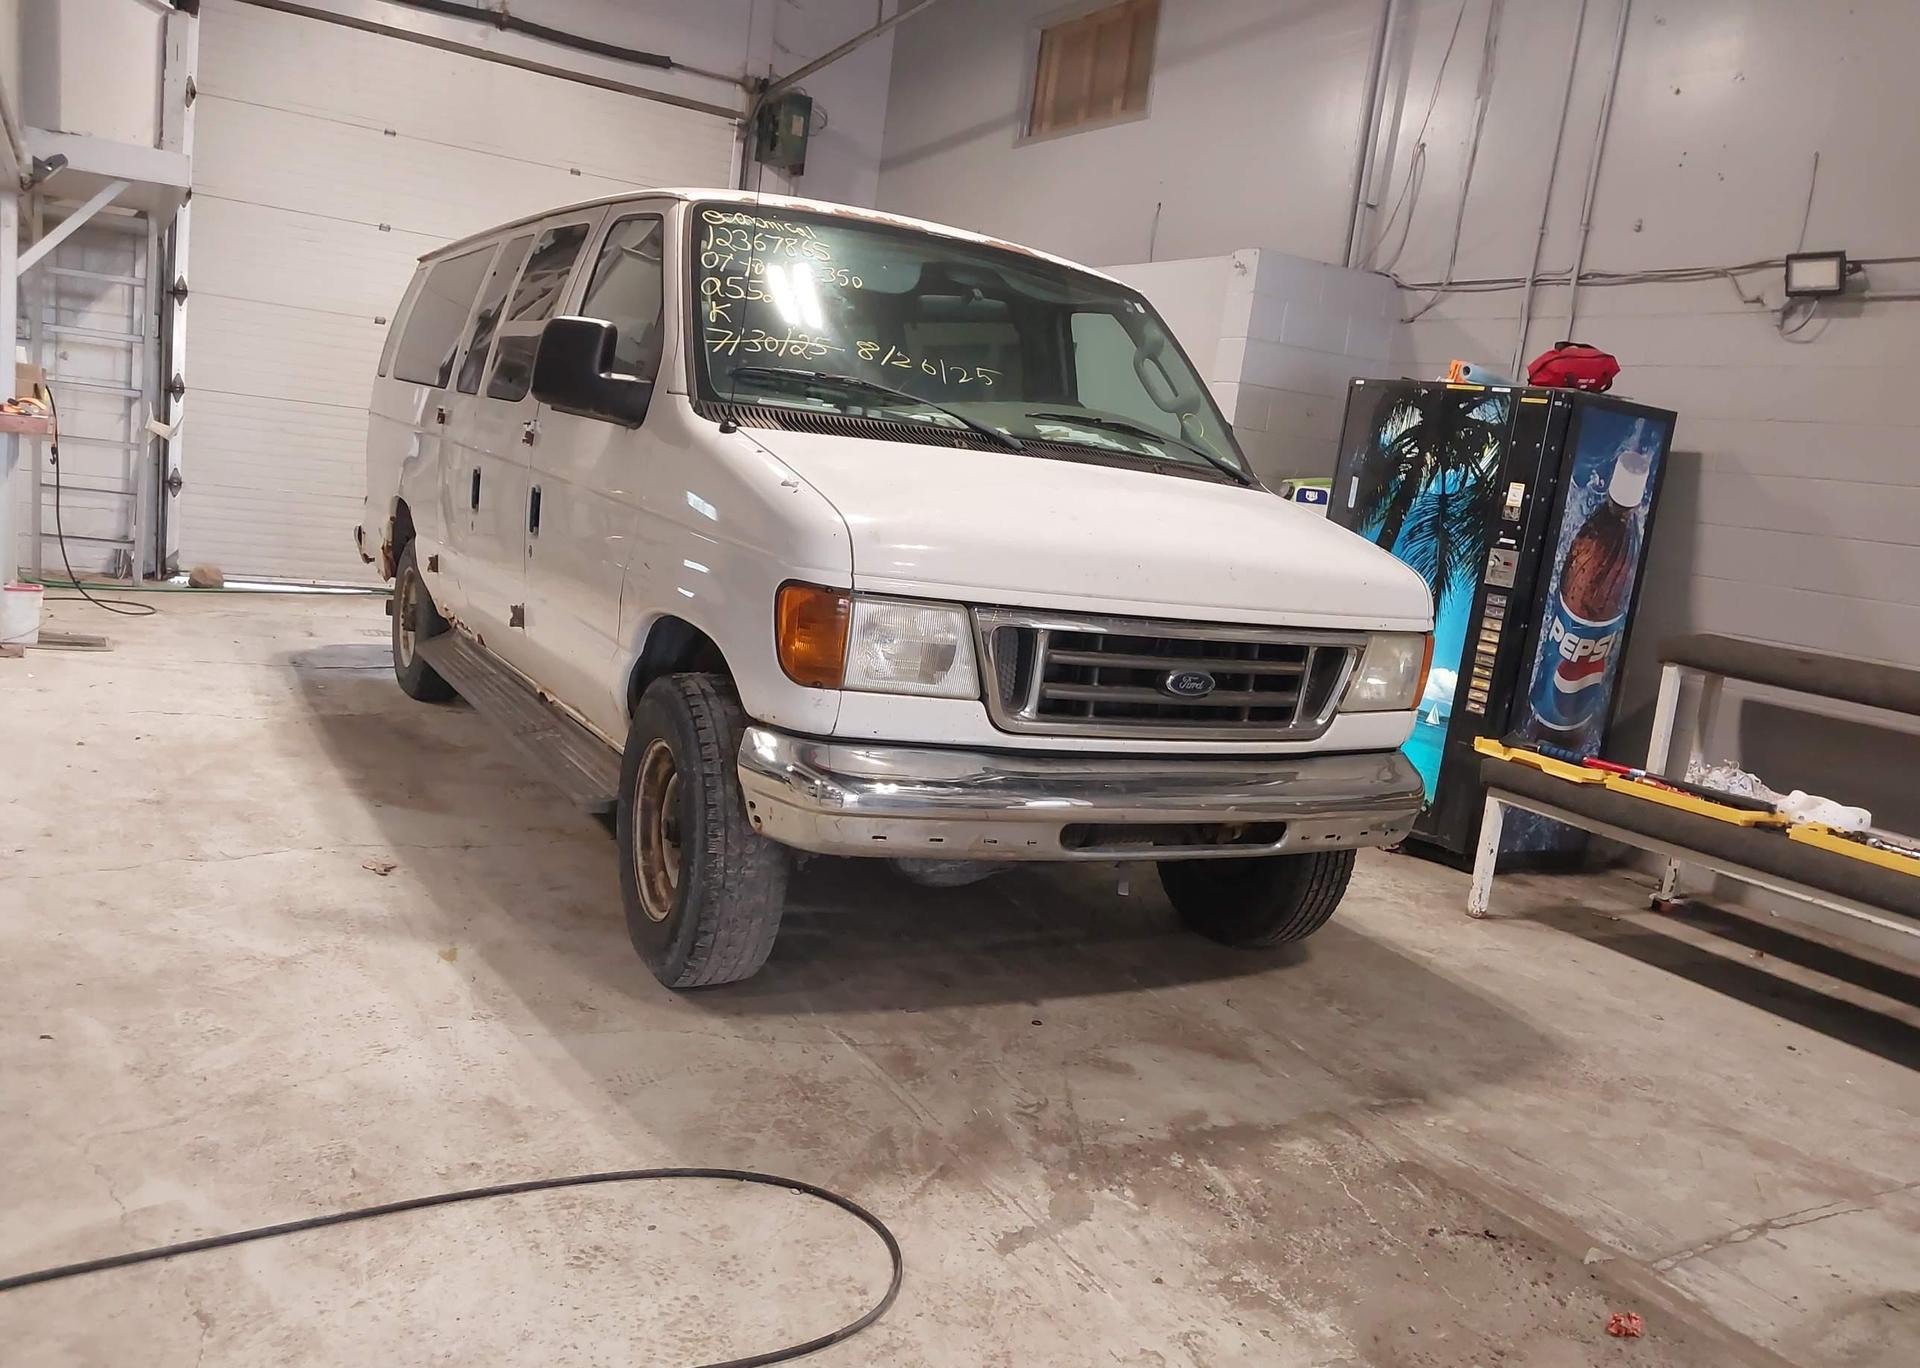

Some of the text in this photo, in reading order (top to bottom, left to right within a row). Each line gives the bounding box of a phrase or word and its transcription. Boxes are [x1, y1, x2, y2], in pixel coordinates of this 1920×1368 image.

[701, 251, 733, 272] 07
[709, 301, 732, 323] K
[1549, 615, 1618, 664] PEPSI
[1178, 676, 1205, 690] Ford
